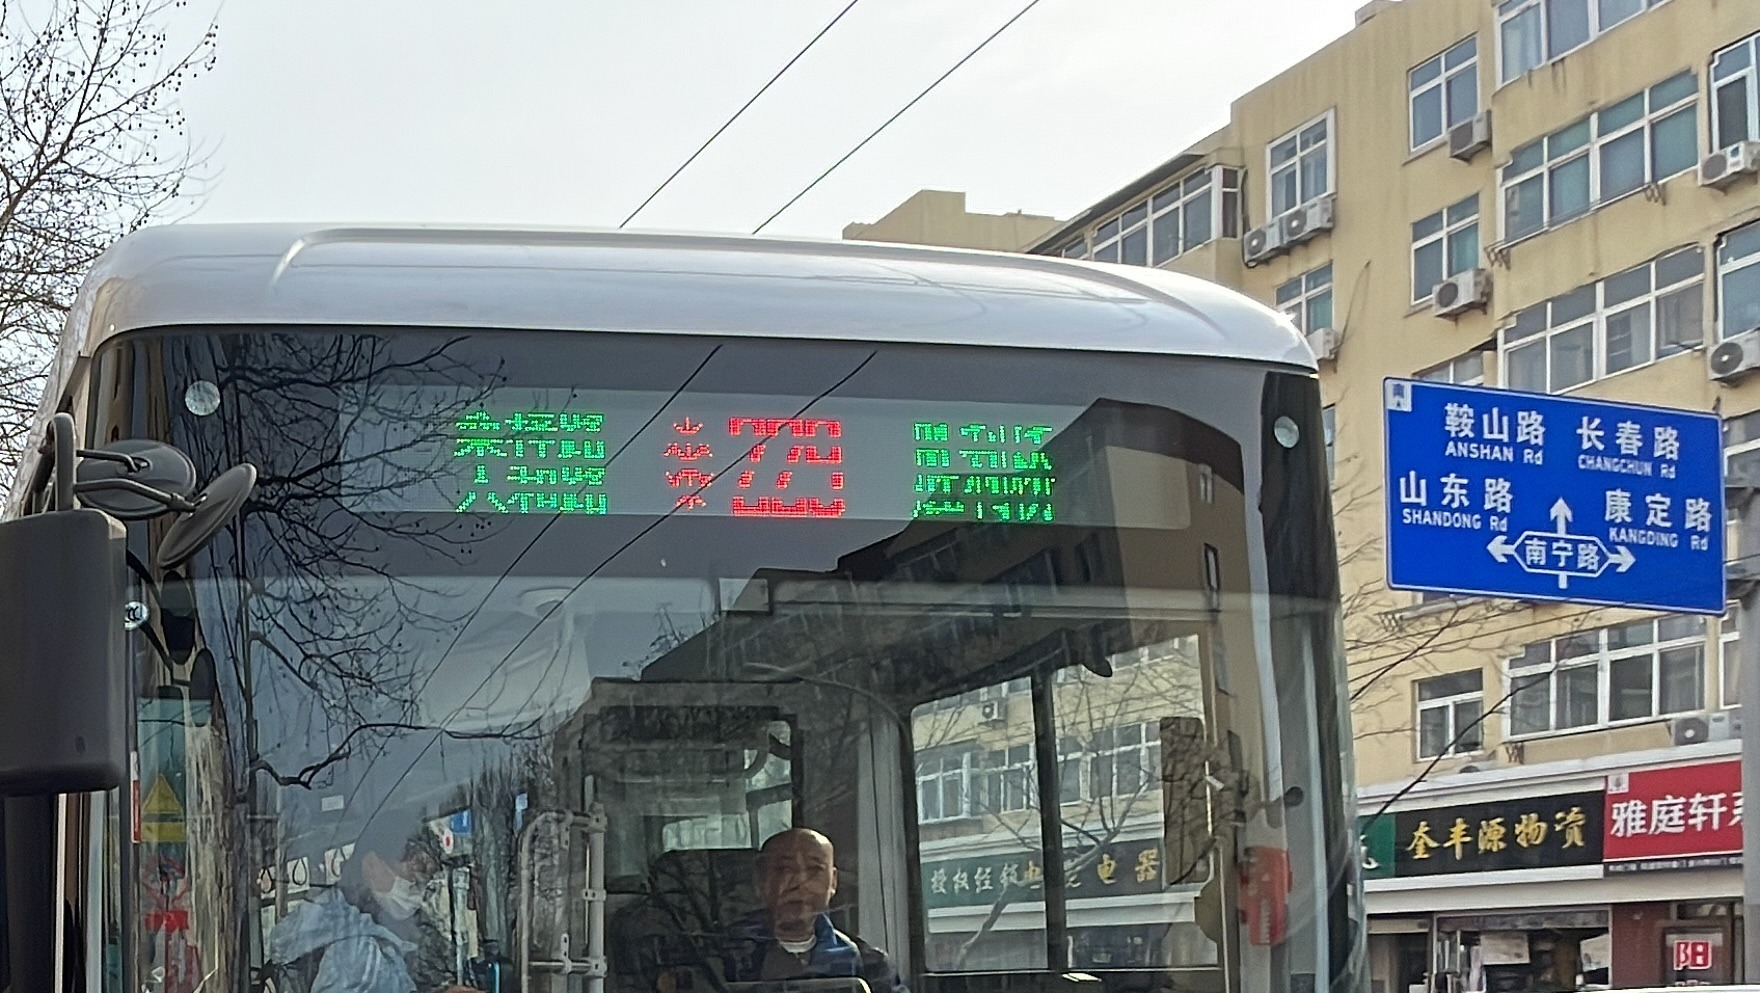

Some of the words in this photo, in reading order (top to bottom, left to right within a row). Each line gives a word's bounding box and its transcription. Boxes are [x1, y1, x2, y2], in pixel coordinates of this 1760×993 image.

[1445, 402, 1546, 446] 鞍山路
[1577, 416, 1681, 461] 长春路
[1445, 441, 1514, 463] ANSHAN
[1523, 446, 1543, 466] Rd
[1578, 454, 1652, 477] CHANGCHUN
[1660, 463, 1676, 480] Rd
[1398, 470, 1513, 514] 山东路
[1402, 508, 1482, 530] SHANDONG
[1489, 516, 1508, 533] Rd
[1604, 488, 1712, 533] 康定路
[1524, 538, 1600, 572] 南宁路
[1609, 527, 1678, 549] KANGDING
[1691, 535, 1708, 551] Rd
